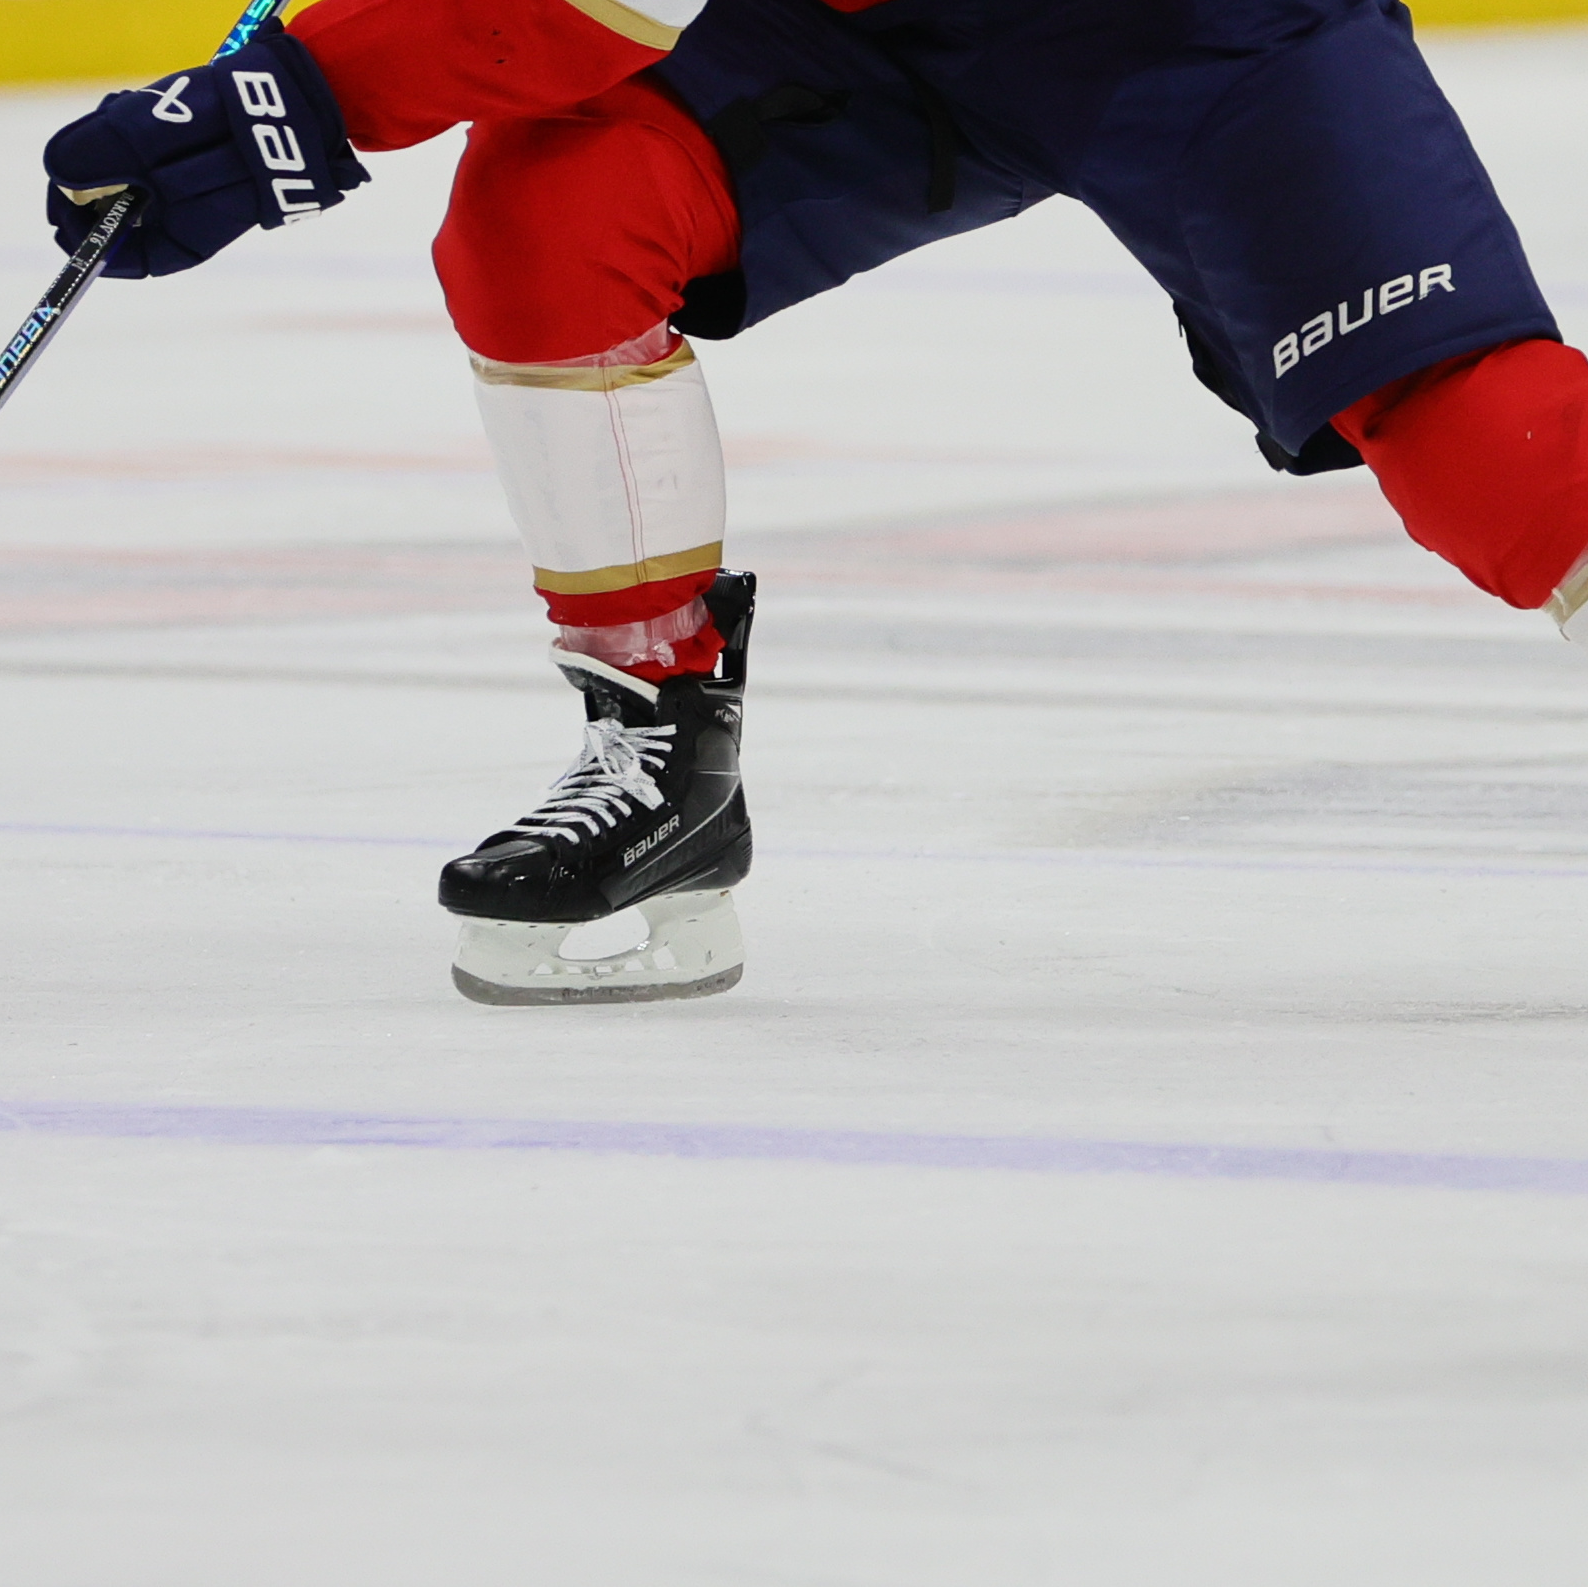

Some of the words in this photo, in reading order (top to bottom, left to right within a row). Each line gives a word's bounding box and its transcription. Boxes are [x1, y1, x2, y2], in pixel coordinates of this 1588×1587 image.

[89, 229, 106, 246] 16
[100, 190, 136, 236] BARKOV
[1273, 263, 1456, 380] BAUER
[622, 813, 681, 868] BAUER
